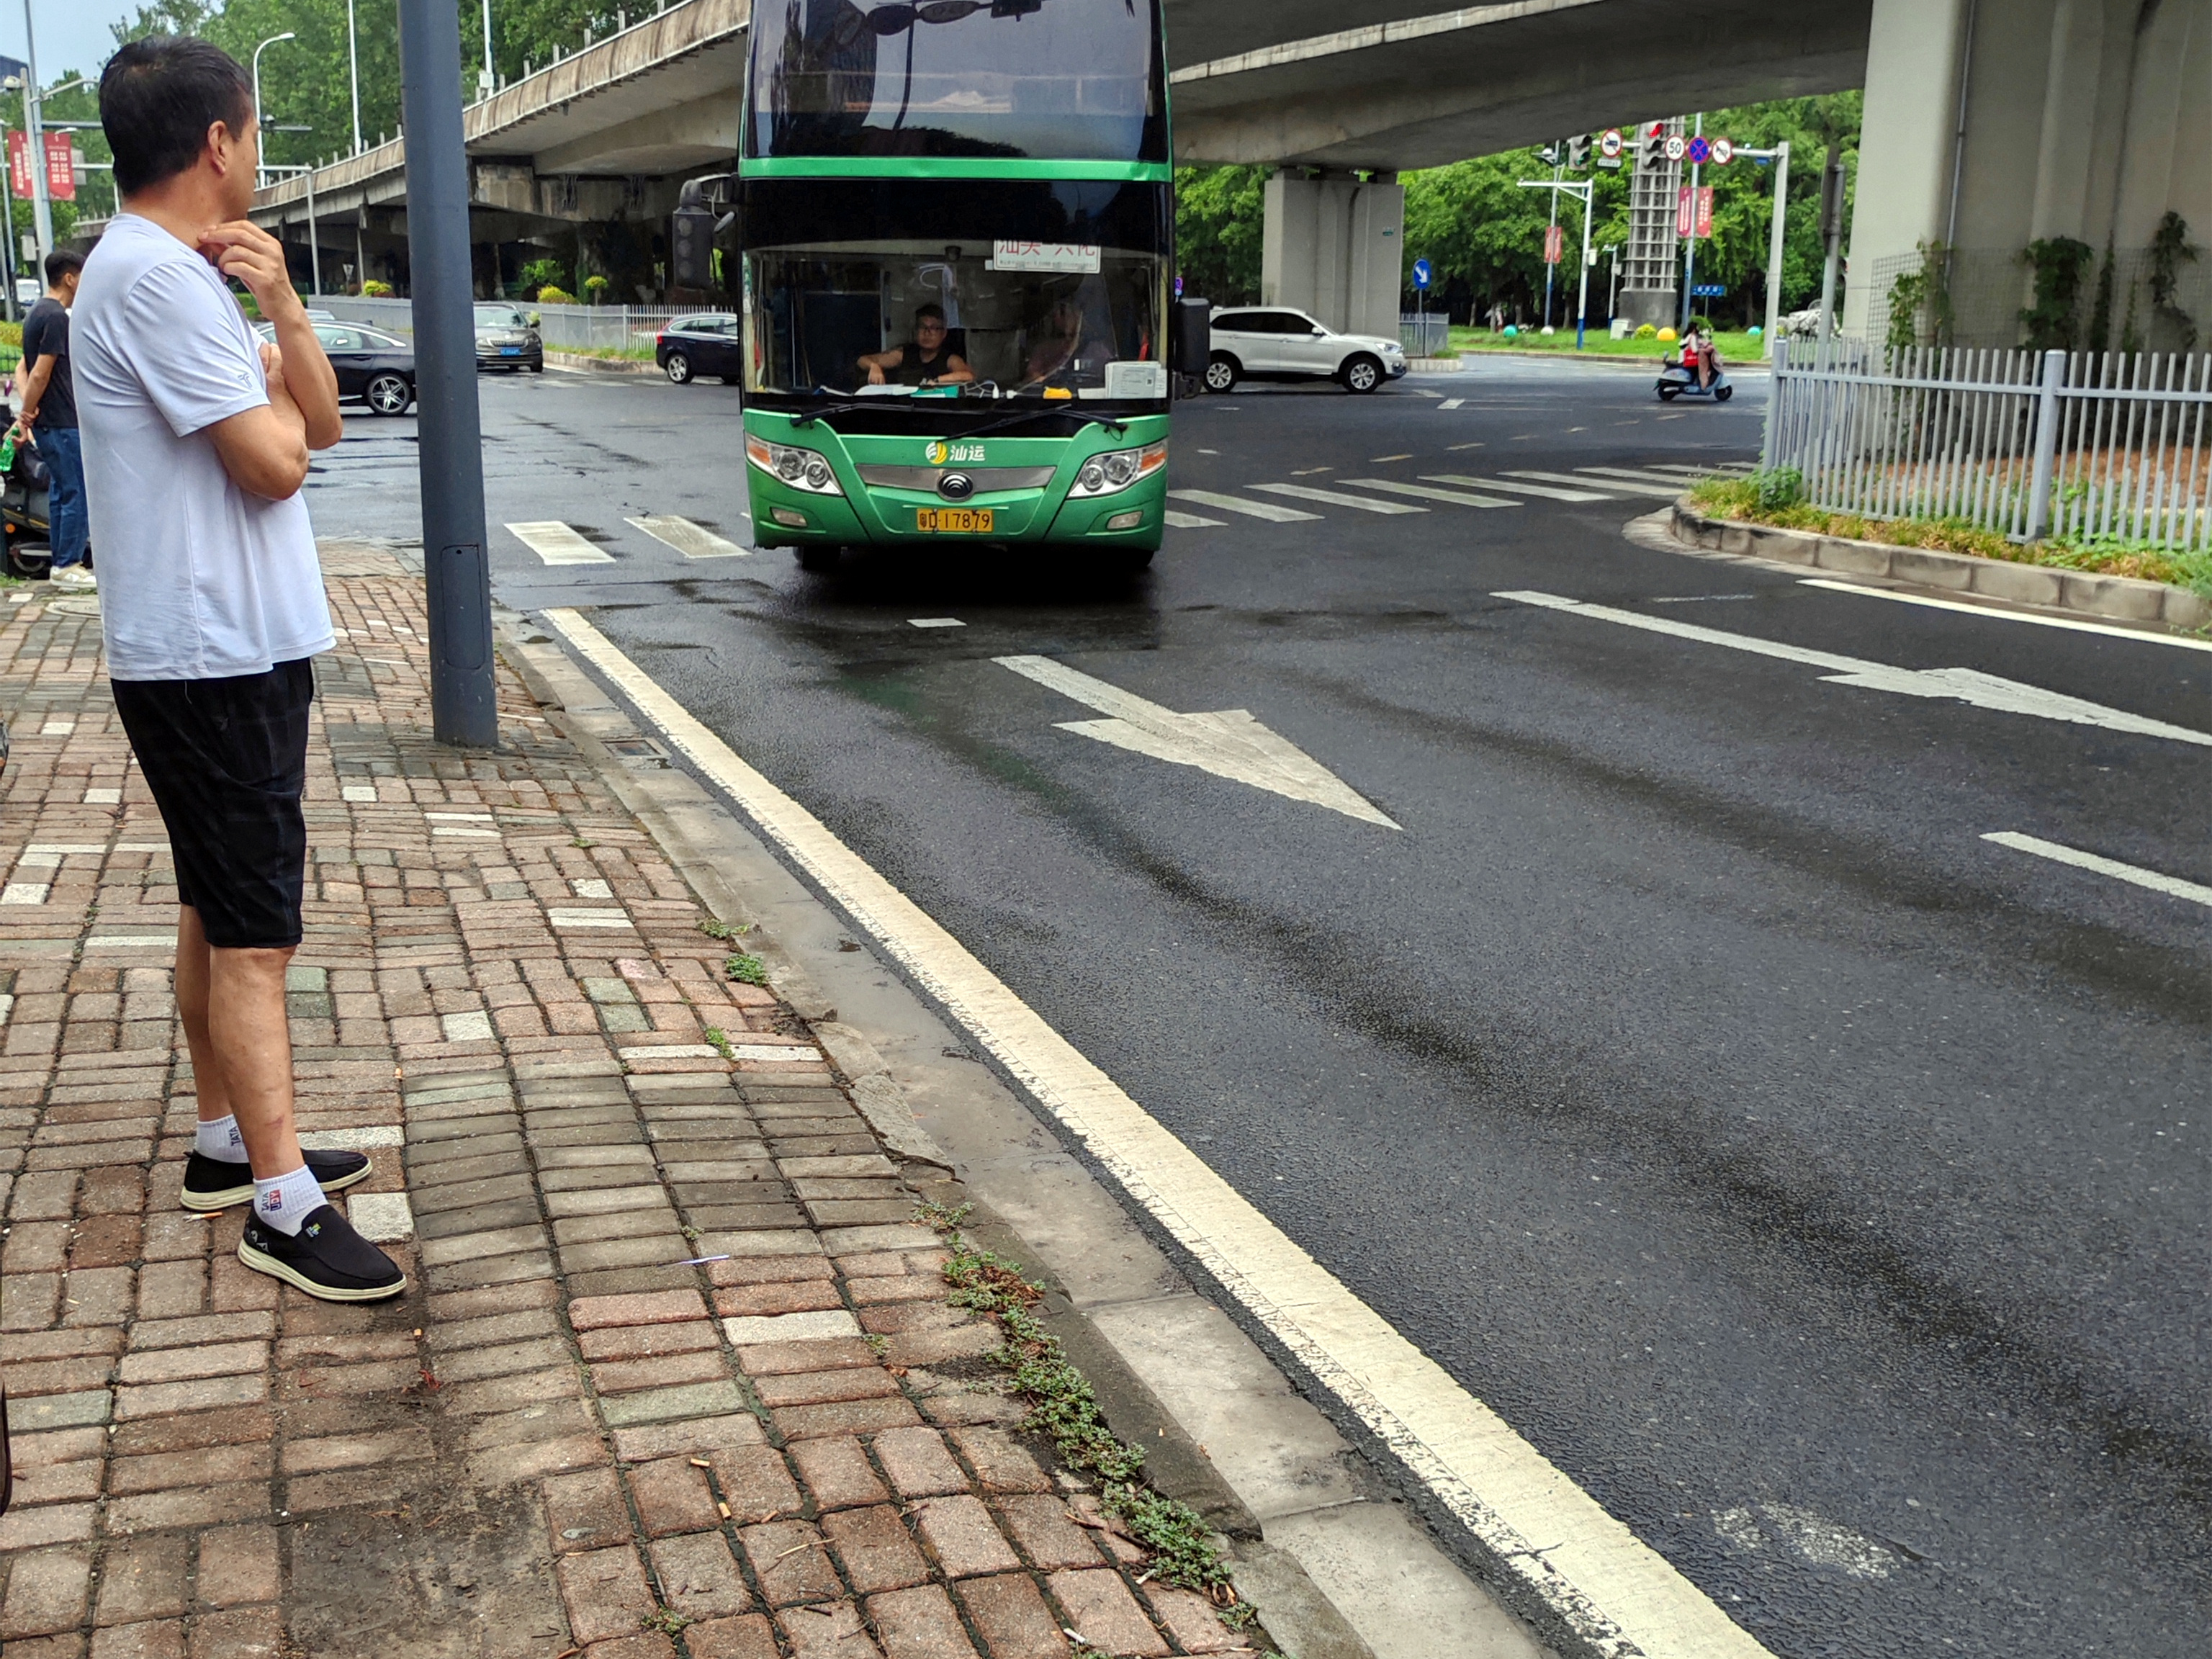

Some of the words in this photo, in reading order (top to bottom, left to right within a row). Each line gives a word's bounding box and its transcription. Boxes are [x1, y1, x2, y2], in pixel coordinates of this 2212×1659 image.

[1669, 142, 1681, 154] 50
[949, 444, 986, 462] 汕运
[229, 1126, 241, 1146] TATA
[261, 1192, 270, 1212] TATA
